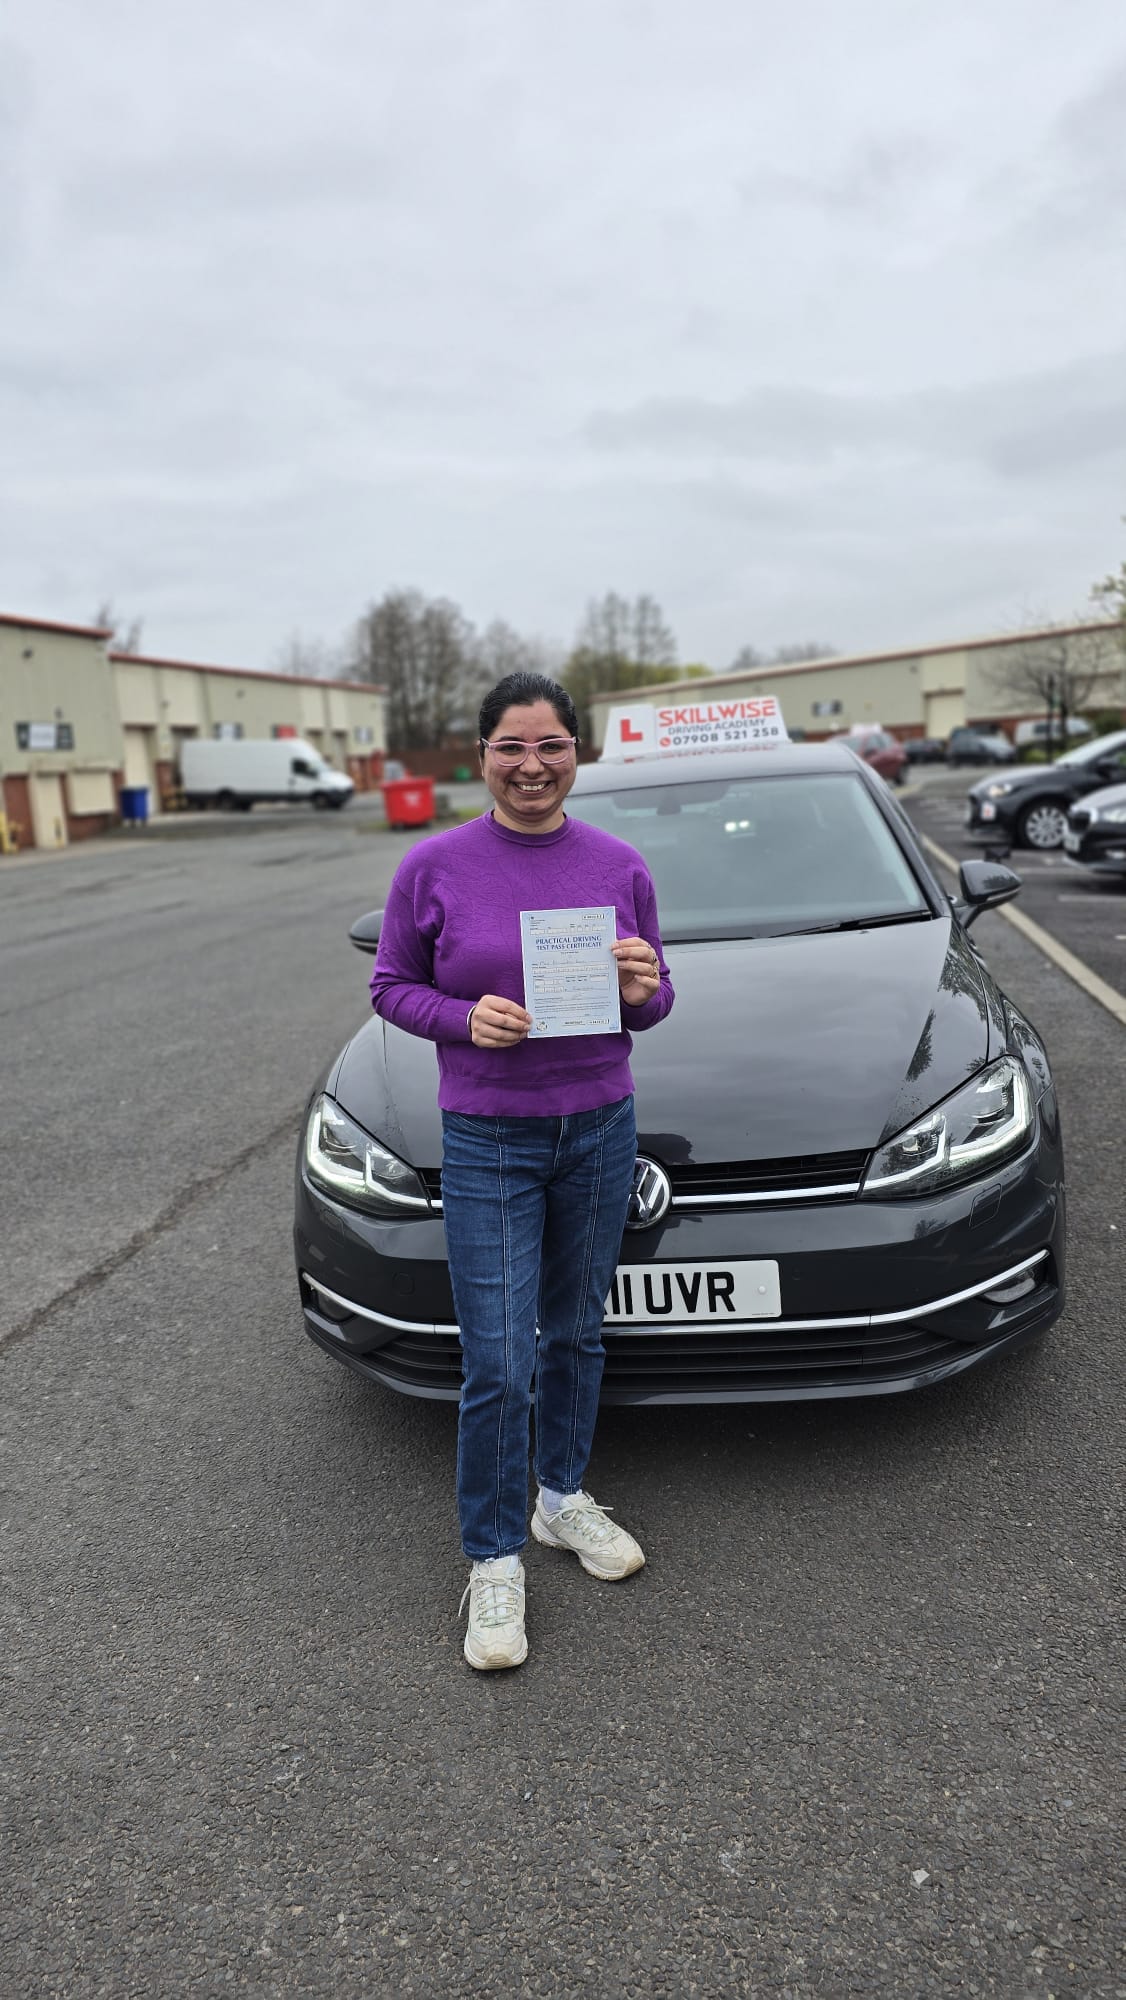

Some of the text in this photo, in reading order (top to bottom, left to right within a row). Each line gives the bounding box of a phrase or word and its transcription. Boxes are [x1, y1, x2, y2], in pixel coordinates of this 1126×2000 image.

[659, 700, 776, 727] SKILLWISE
[621, 719, 643, 742] L
[667, 719, 766, 736] DRIVING ACADEMY
[673, 727, 779, 746] 07908 521 258
[536, 937, 570, 945] PRACTICAL
[643, 1271, 736, 1315] UVR
